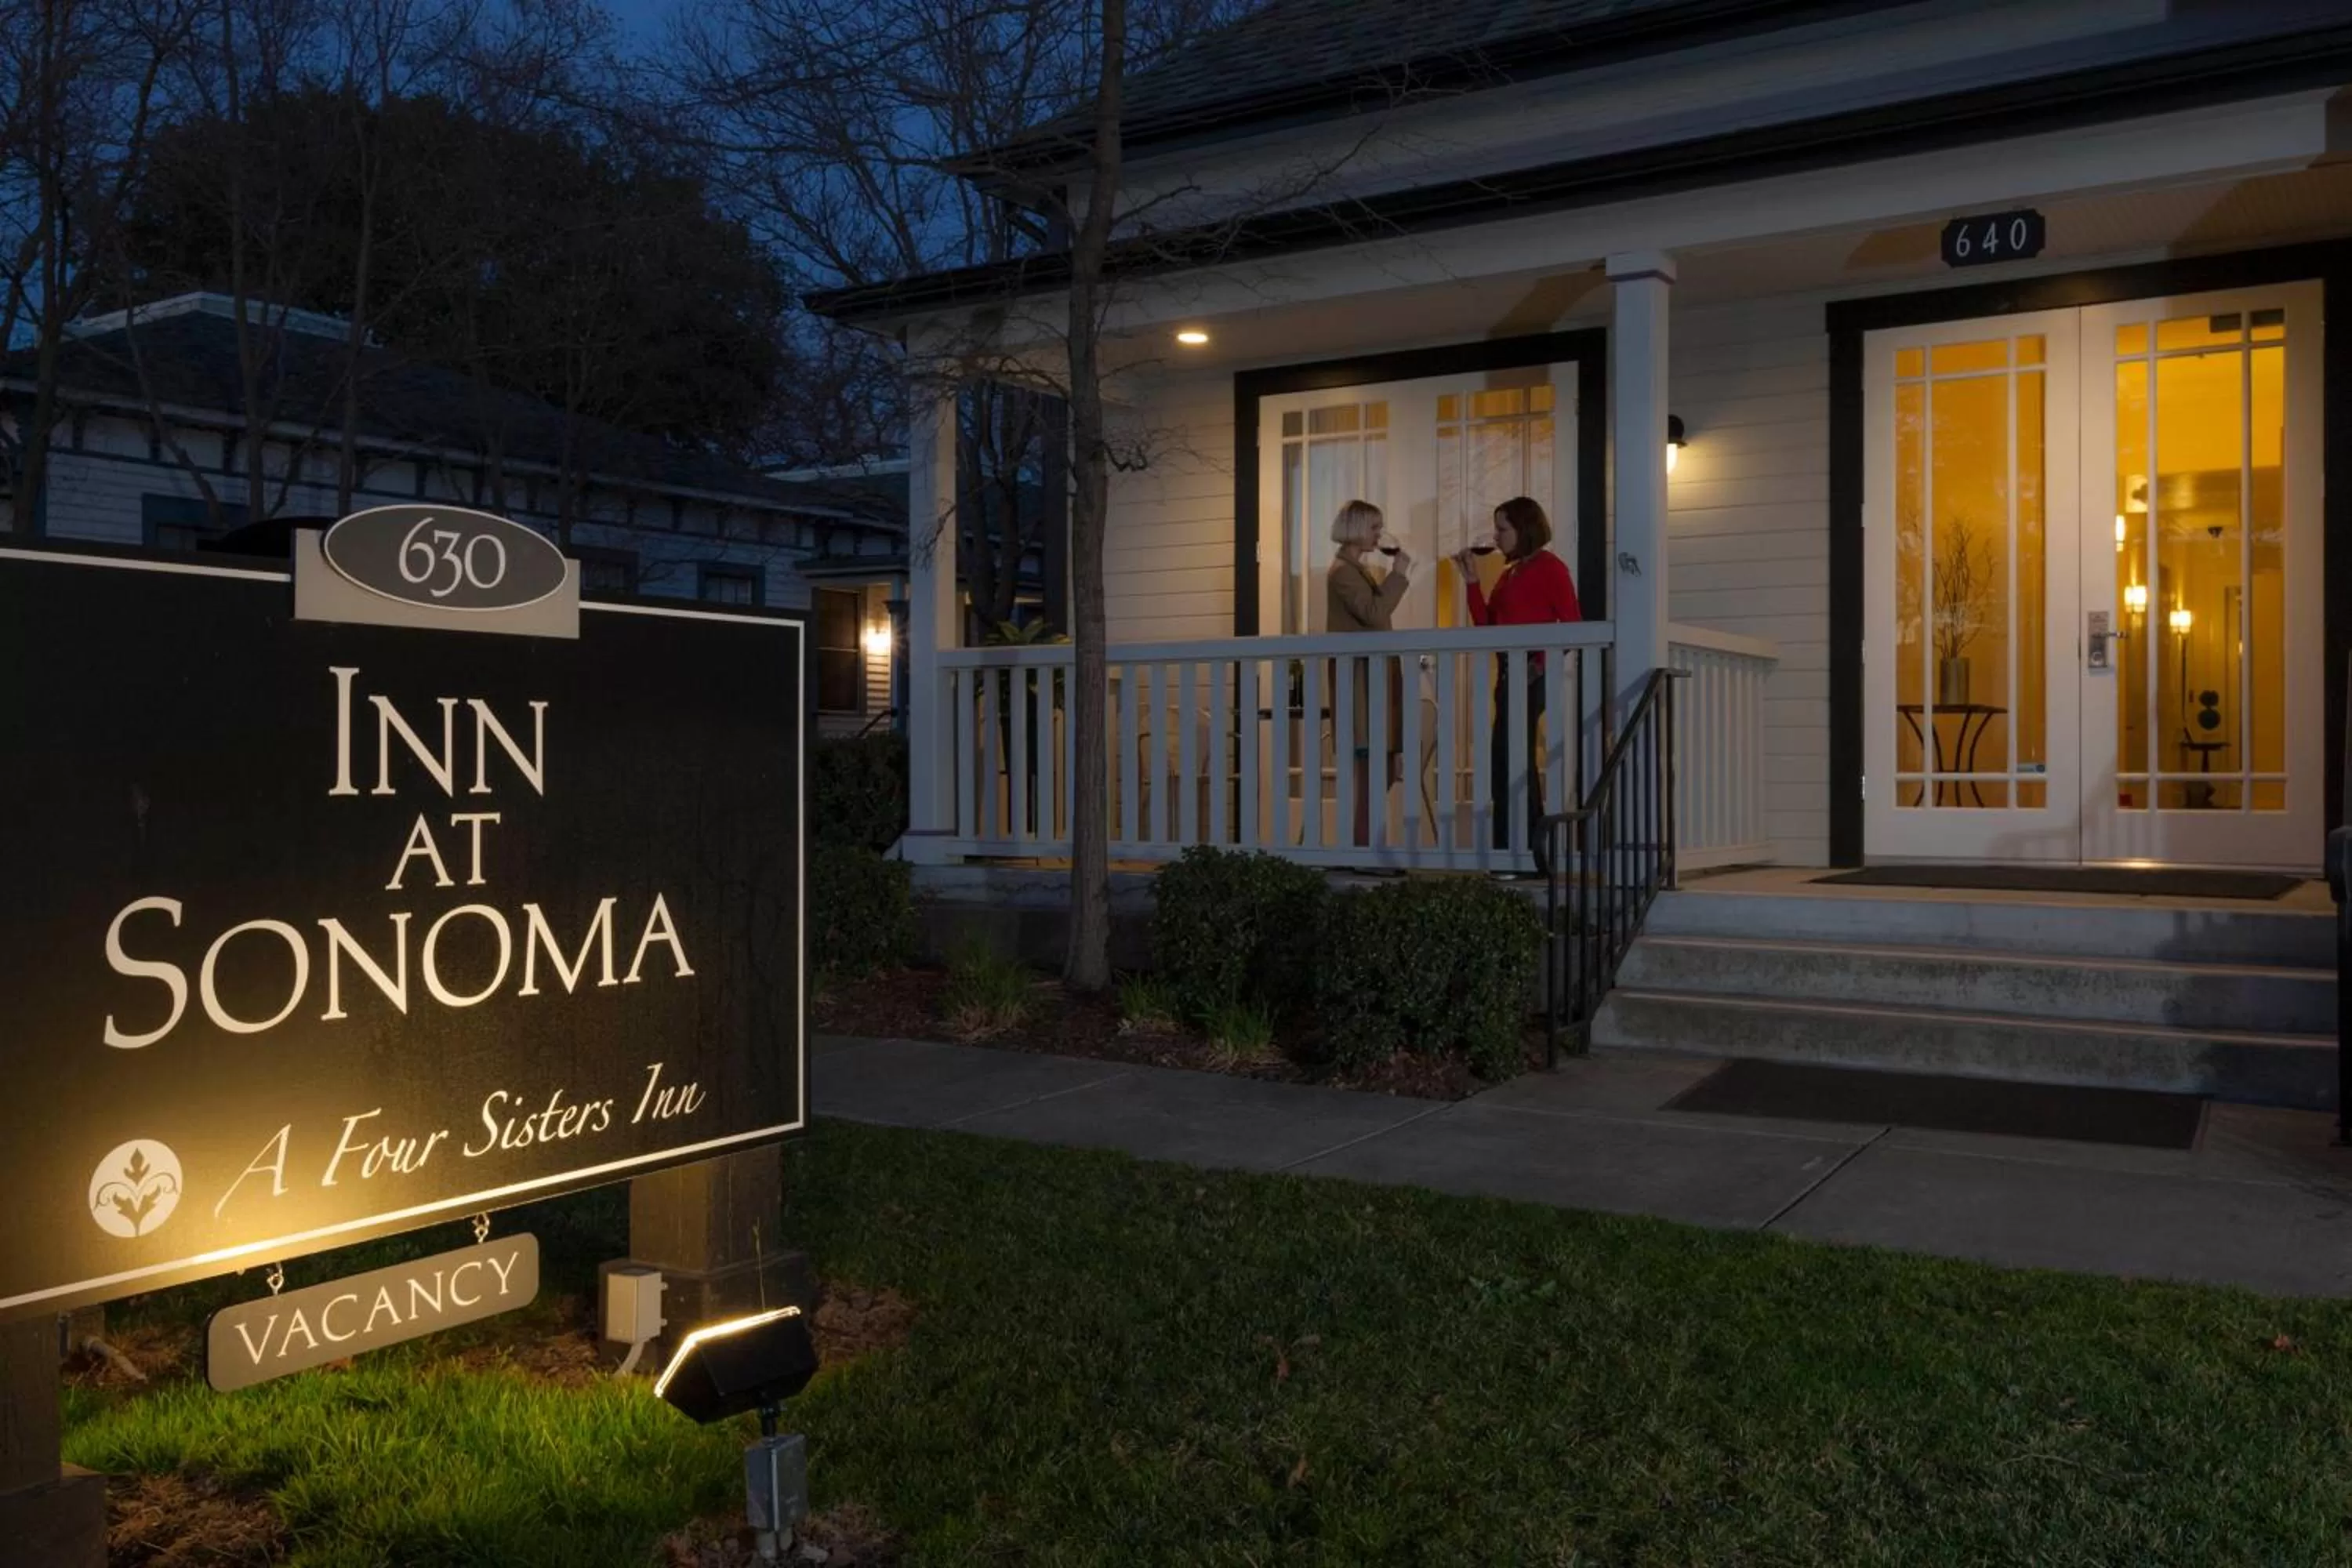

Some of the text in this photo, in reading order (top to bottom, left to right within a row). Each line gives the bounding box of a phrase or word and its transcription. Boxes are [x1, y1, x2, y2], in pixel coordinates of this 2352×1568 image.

[1955, 218, 2027, 257] 640
[398, 517, 506, 597] 630
[328, 666, 549, 797] INN
[385, 811, 501, 891] AT
[103, 892, 695, 1049] SONOMA
[214, 1062, 706, 1218] A Four Sisters Inn
[234, 1250, 521, 1366] VACANCY
